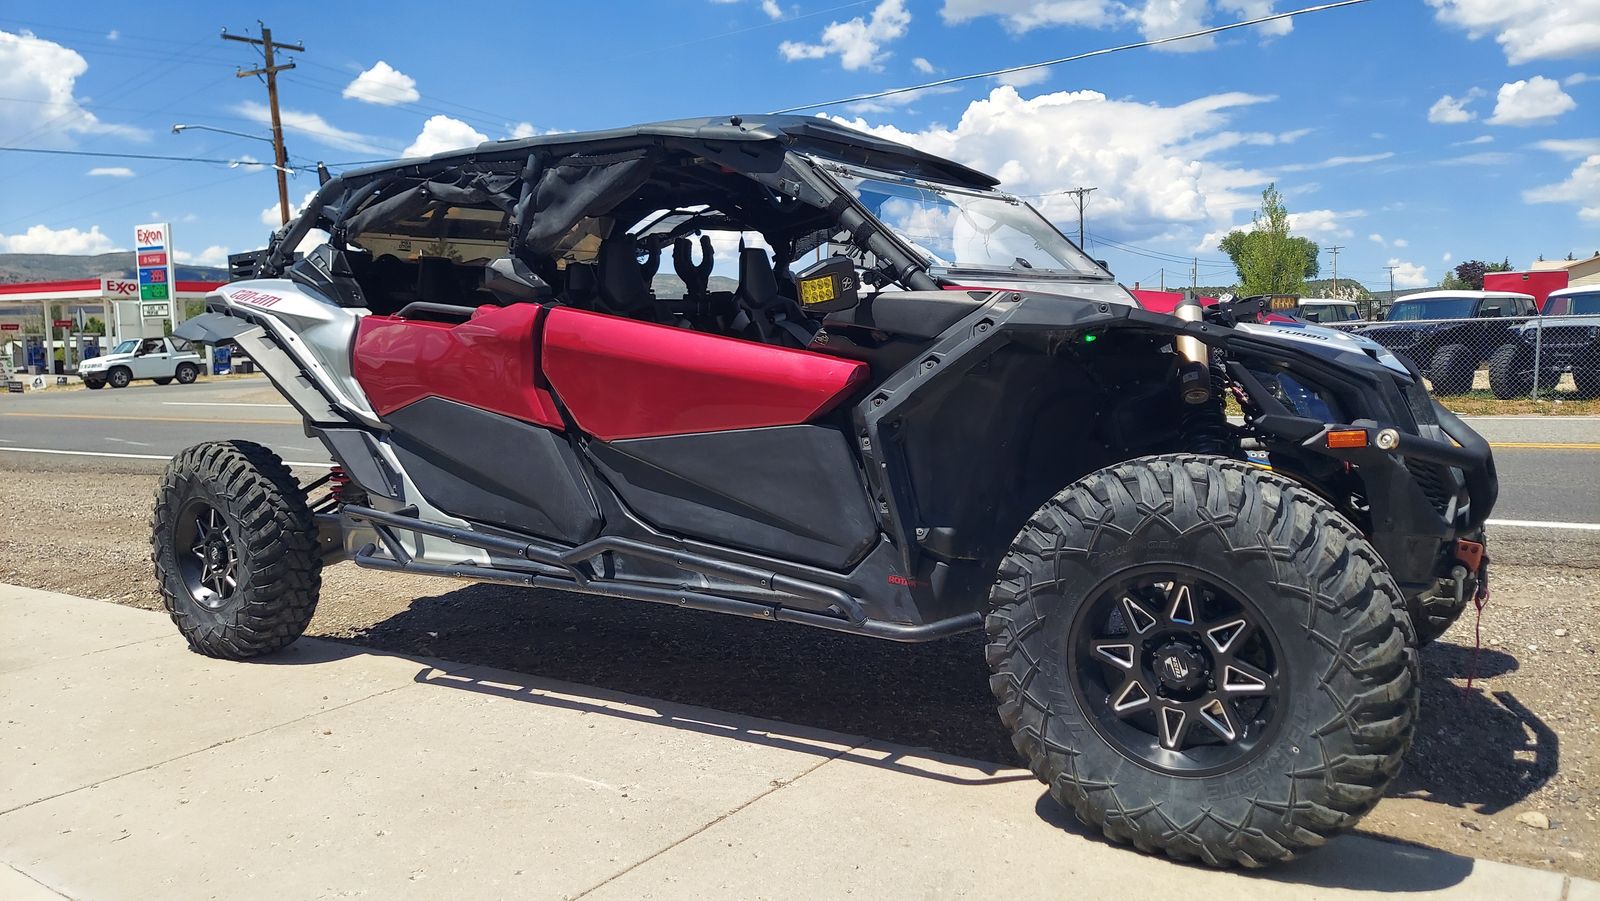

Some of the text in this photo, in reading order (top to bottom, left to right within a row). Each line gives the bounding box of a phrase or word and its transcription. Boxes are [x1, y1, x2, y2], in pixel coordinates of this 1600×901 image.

[137, 229, 163, 245] Exxon
[106, 280, 139, 295] Exxo
[1276, 329, 1328, 340] TURBO
[1170, 656, 1182, 679] TUSK
